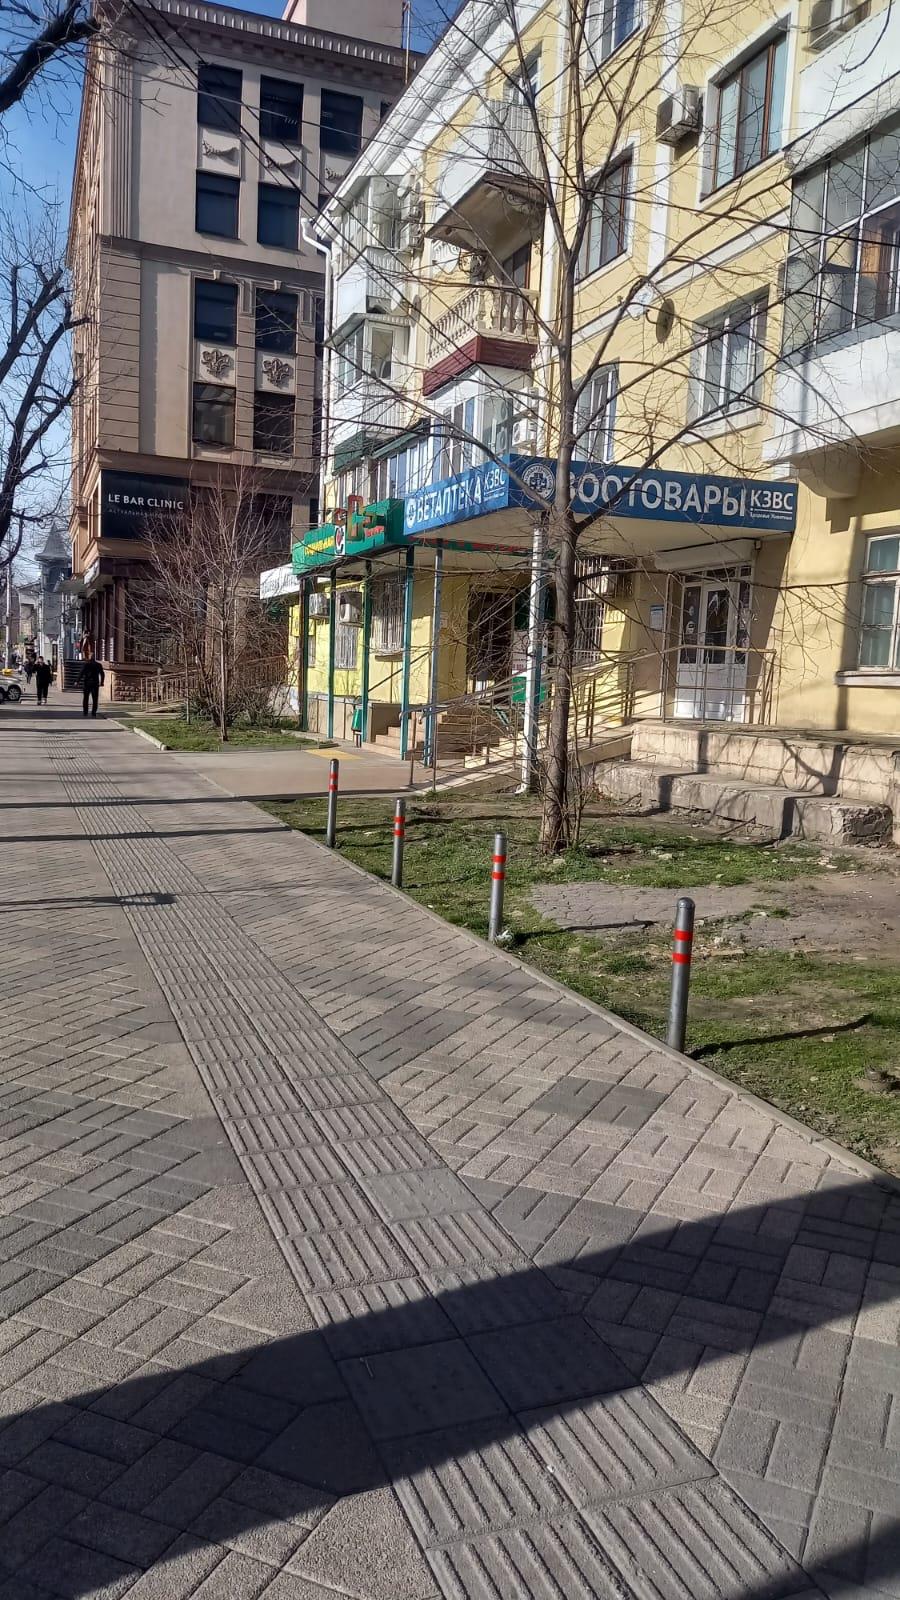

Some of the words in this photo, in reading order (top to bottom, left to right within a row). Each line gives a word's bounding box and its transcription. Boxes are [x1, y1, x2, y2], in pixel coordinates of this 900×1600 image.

[484, 468, 506, 490] КЗВС
[108, 493, 121, 503] LE
[123, 495, 145, 506] BAR
[147, 498, 184, 509] CLINIC
[417, 476, 482, 523] ВЕТАПТЕКА
[750, 489, 793, 510] КЗВС
